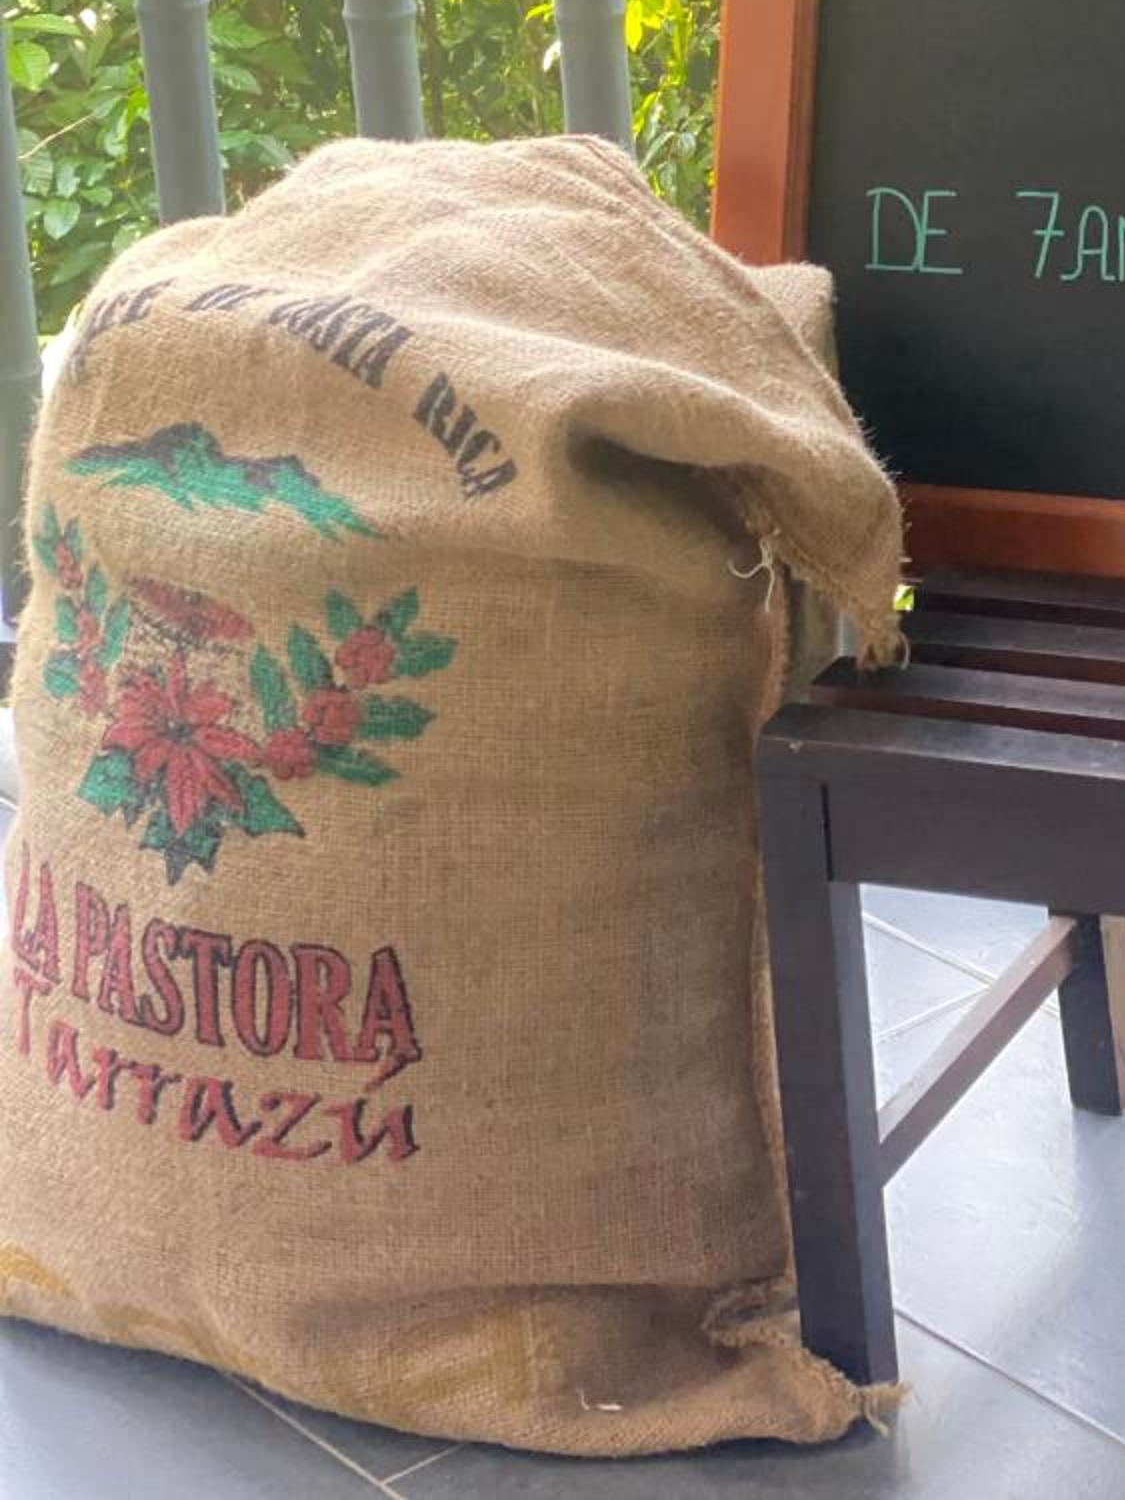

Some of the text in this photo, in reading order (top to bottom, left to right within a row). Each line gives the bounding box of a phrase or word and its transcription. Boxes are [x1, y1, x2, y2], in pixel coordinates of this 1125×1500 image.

[864, 186, 964, 275] DE
[411, 371, 520, 503] RICA
[12, 838, 423, 1063] LA PASTORA
